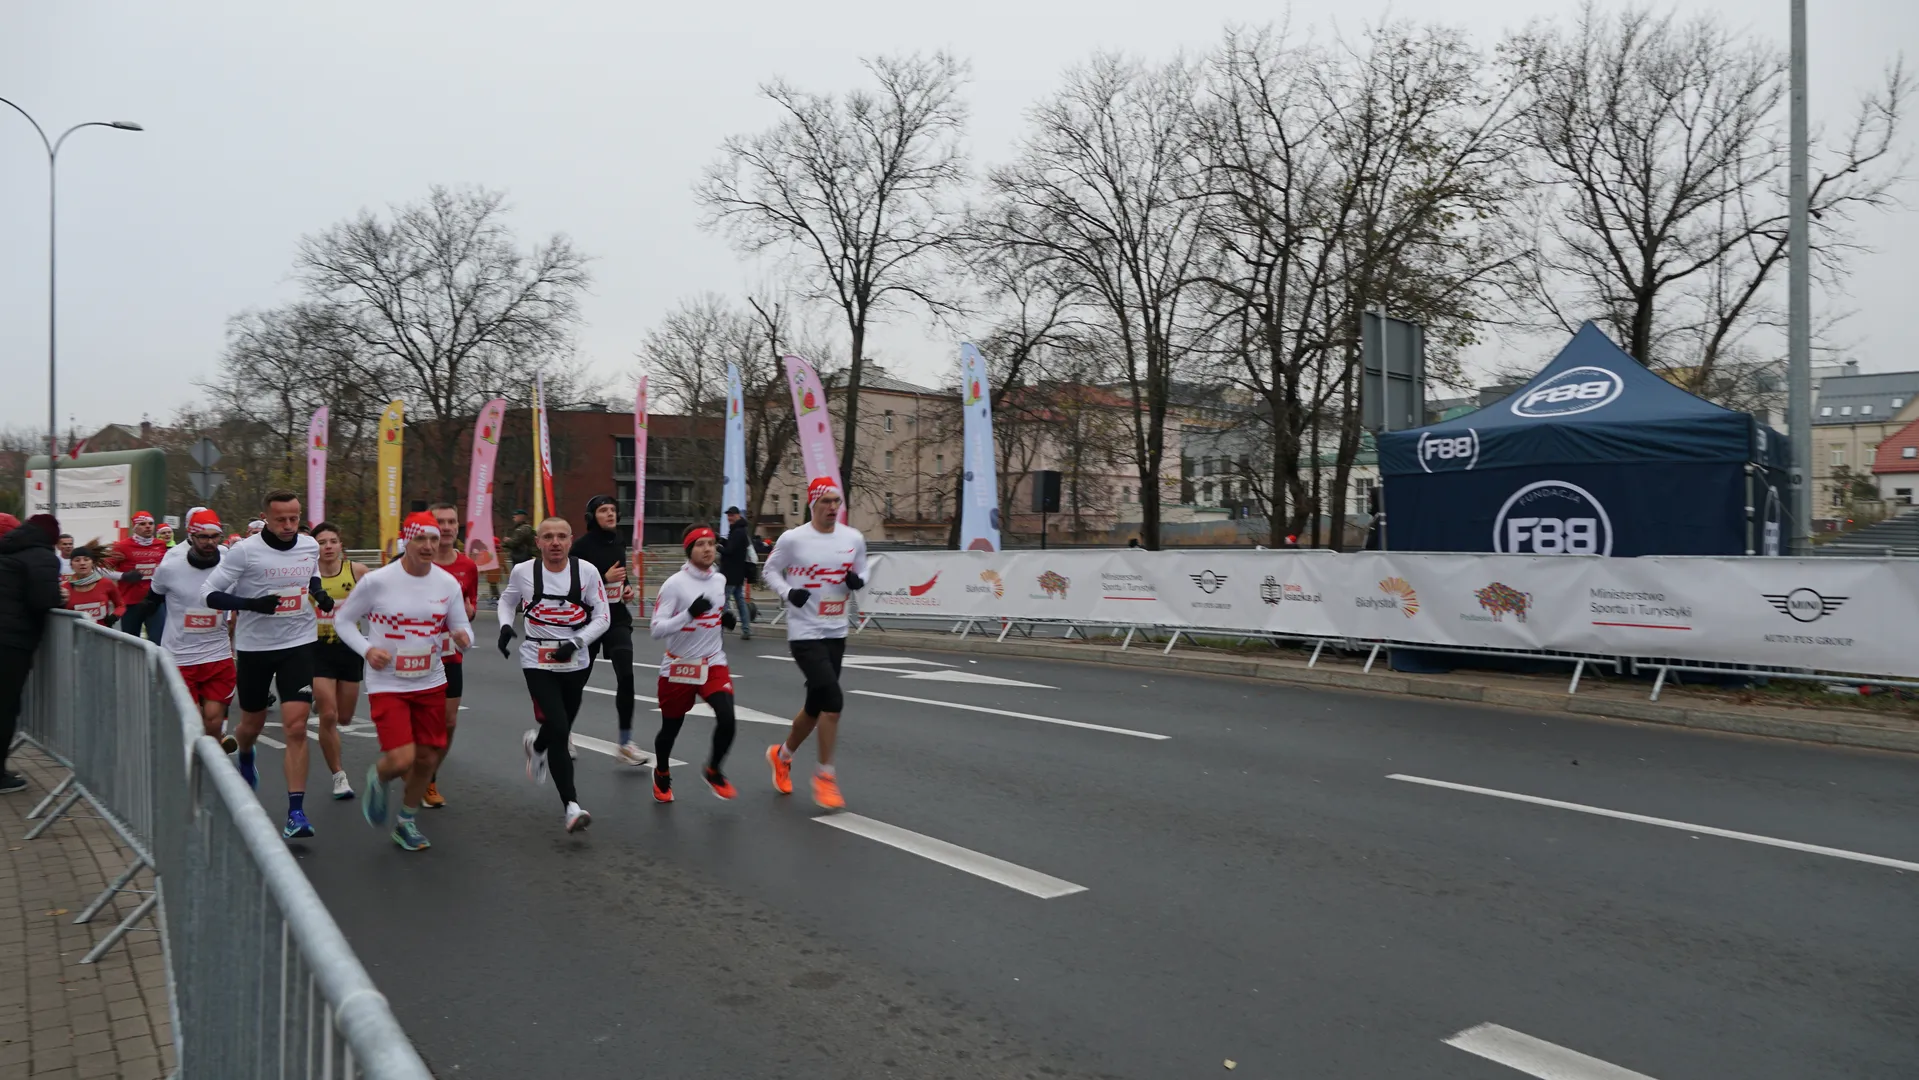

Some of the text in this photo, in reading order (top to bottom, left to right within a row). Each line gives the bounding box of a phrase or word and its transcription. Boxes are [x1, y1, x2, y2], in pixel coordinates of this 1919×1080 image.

[264, 566, 311, 578] 1919-2019
[1590, 588, 1665, 602] Ministerstwo
[1355, 596, 1398, 610] Białystok
[1791, 600, 1820, 610] MINI
[1590, 602, 1628, 615] Sportu
[1636, 604, 1692, 619] Turystyki
[403, 657, 425, 669] 394
[676, 666, 696, 675] 505
